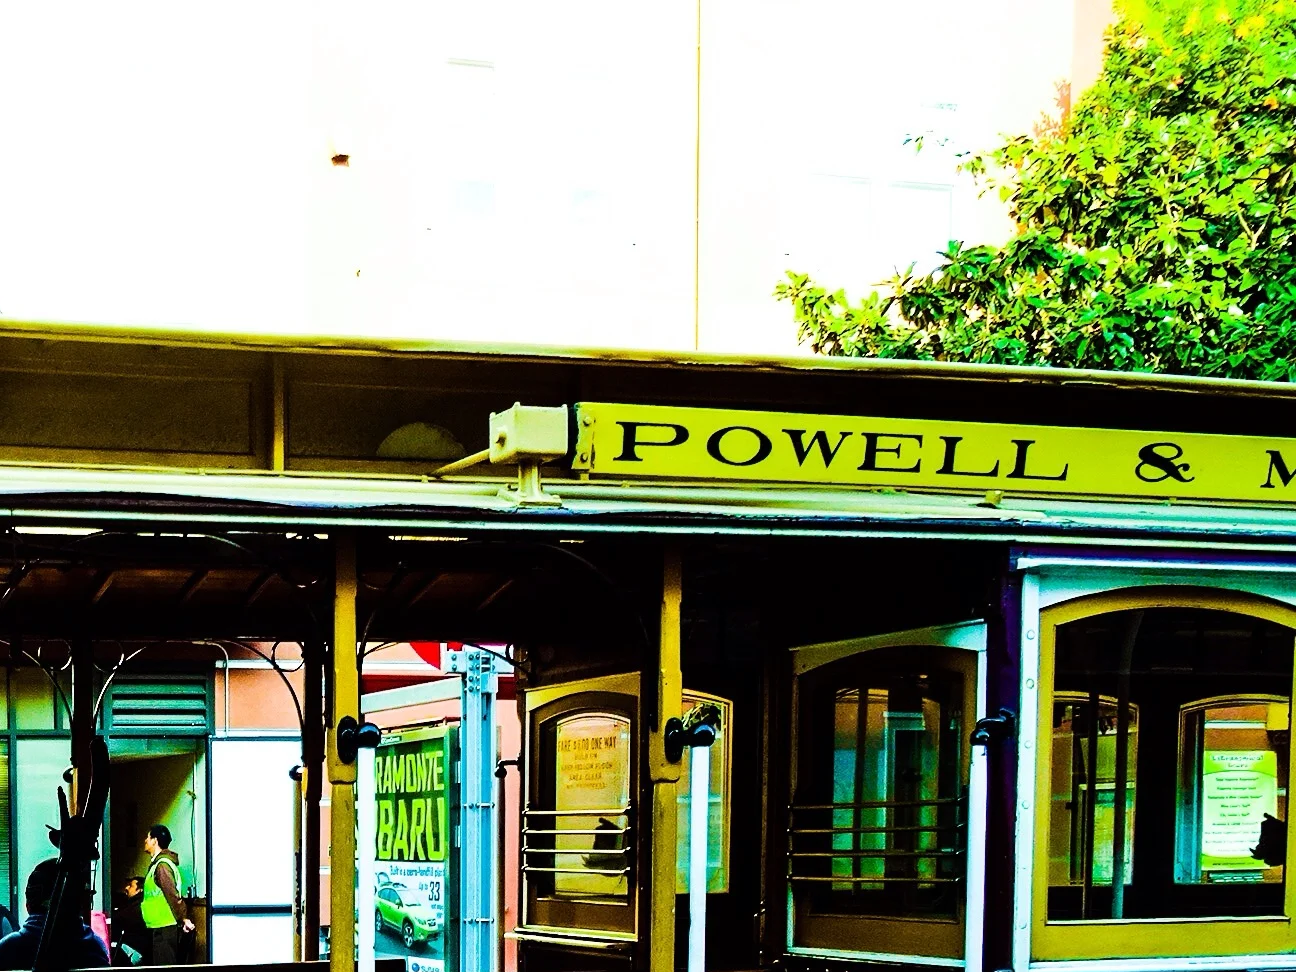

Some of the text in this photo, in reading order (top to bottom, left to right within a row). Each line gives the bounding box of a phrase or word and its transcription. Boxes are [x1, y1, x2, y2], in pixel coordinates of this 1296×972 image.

[613, 420, 1069, 482] POWELL
[1136, 441, 1195, 484] &
[375, 750, 444, 794] RAMONTE
[375, 798, 445, 861] BARU
[428, 881, 441, 902] 33
